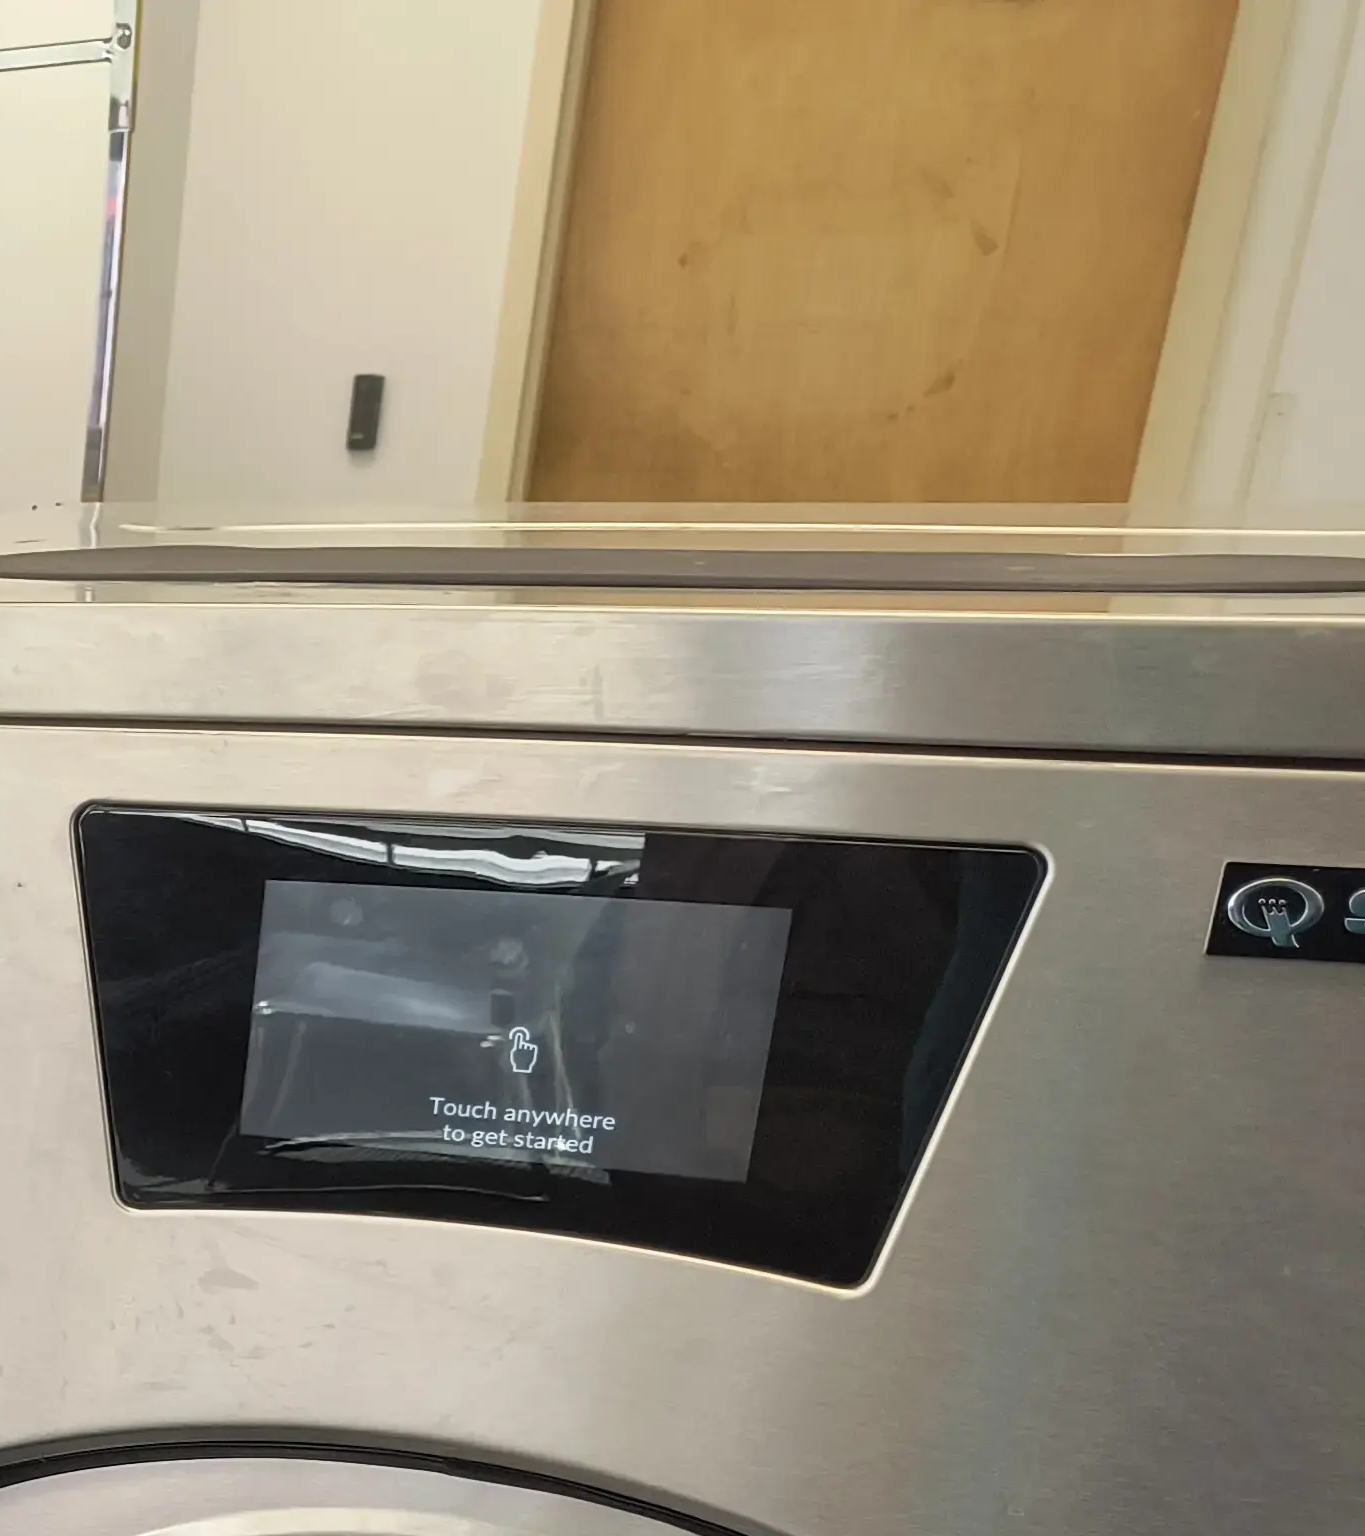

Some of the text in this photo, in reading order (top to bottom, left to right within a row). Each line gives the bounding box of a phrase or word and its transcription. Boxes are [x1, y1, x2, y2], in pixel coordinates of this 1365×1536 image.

[429, 1096, 616, 1131] Touch anywhere
[442, 1124, 594, 1154] to get started
